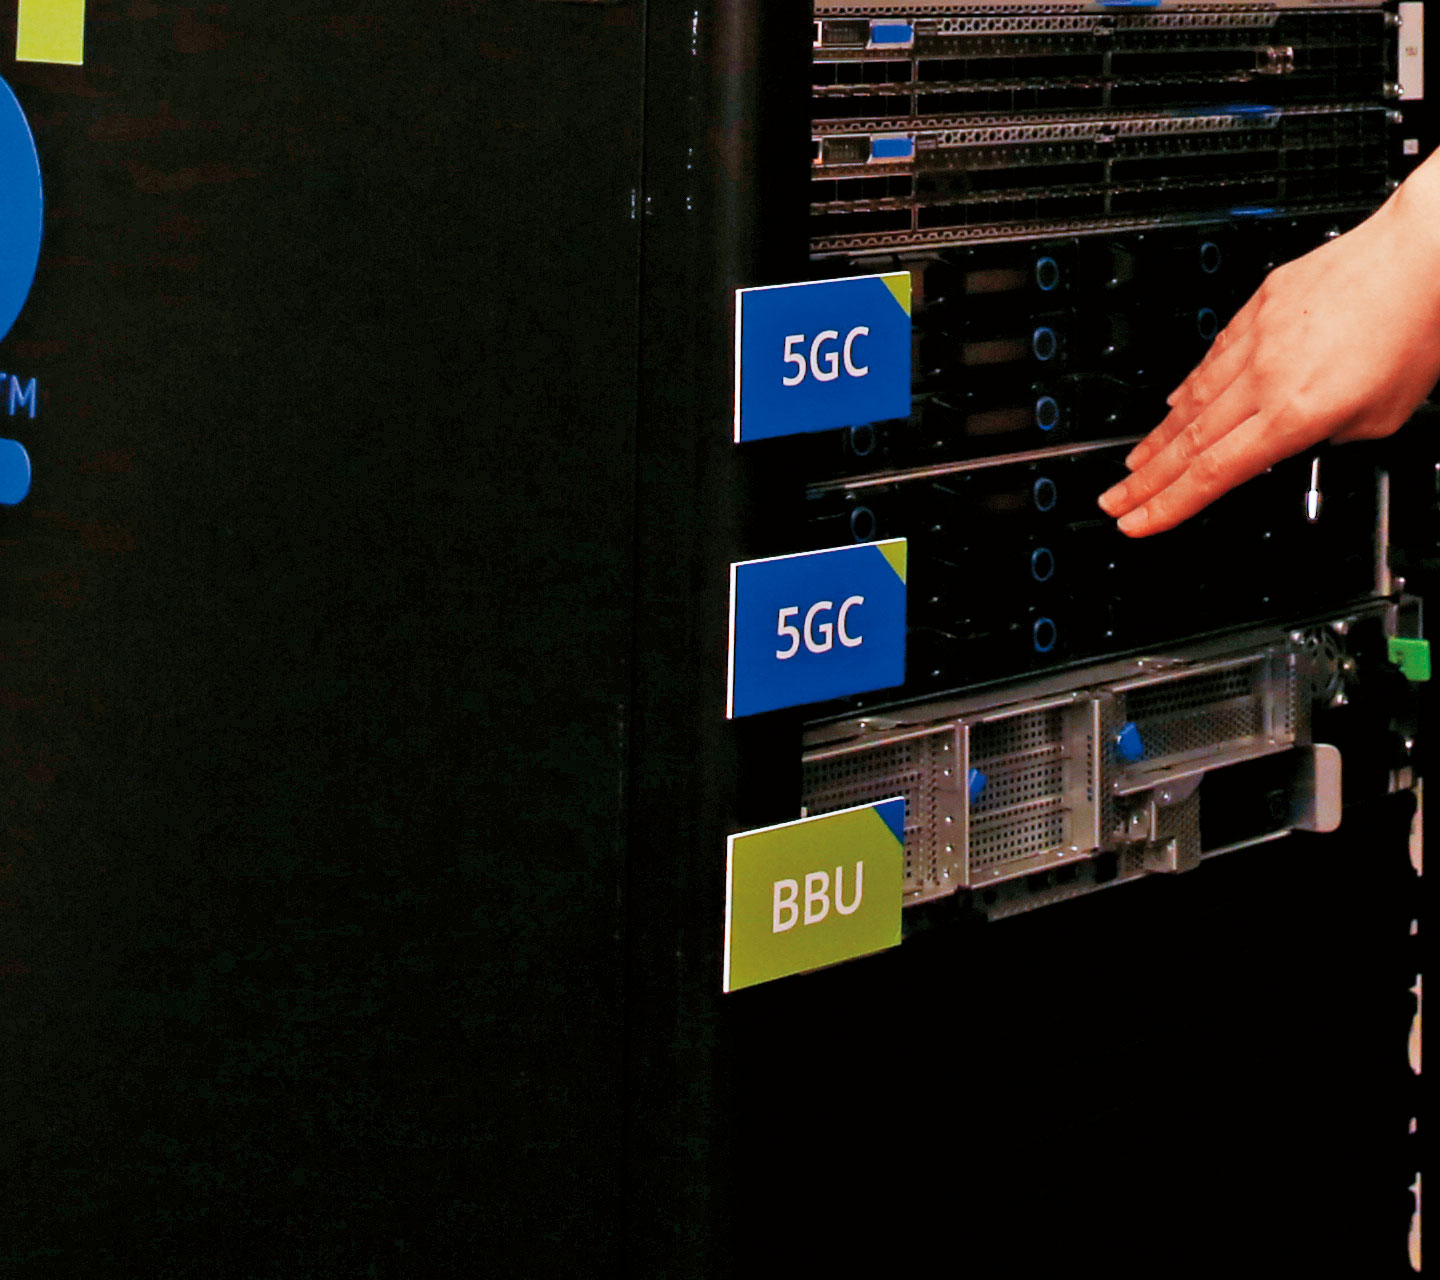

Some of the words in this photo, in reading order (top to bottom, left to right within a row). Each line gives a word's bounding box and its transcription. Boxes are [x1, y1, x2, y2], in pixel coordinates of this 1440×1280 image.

[782, 326, 870, 388] 5GC
[775, 595, 864, 661] 5GC
[772, 861, 864, 934] BBU
